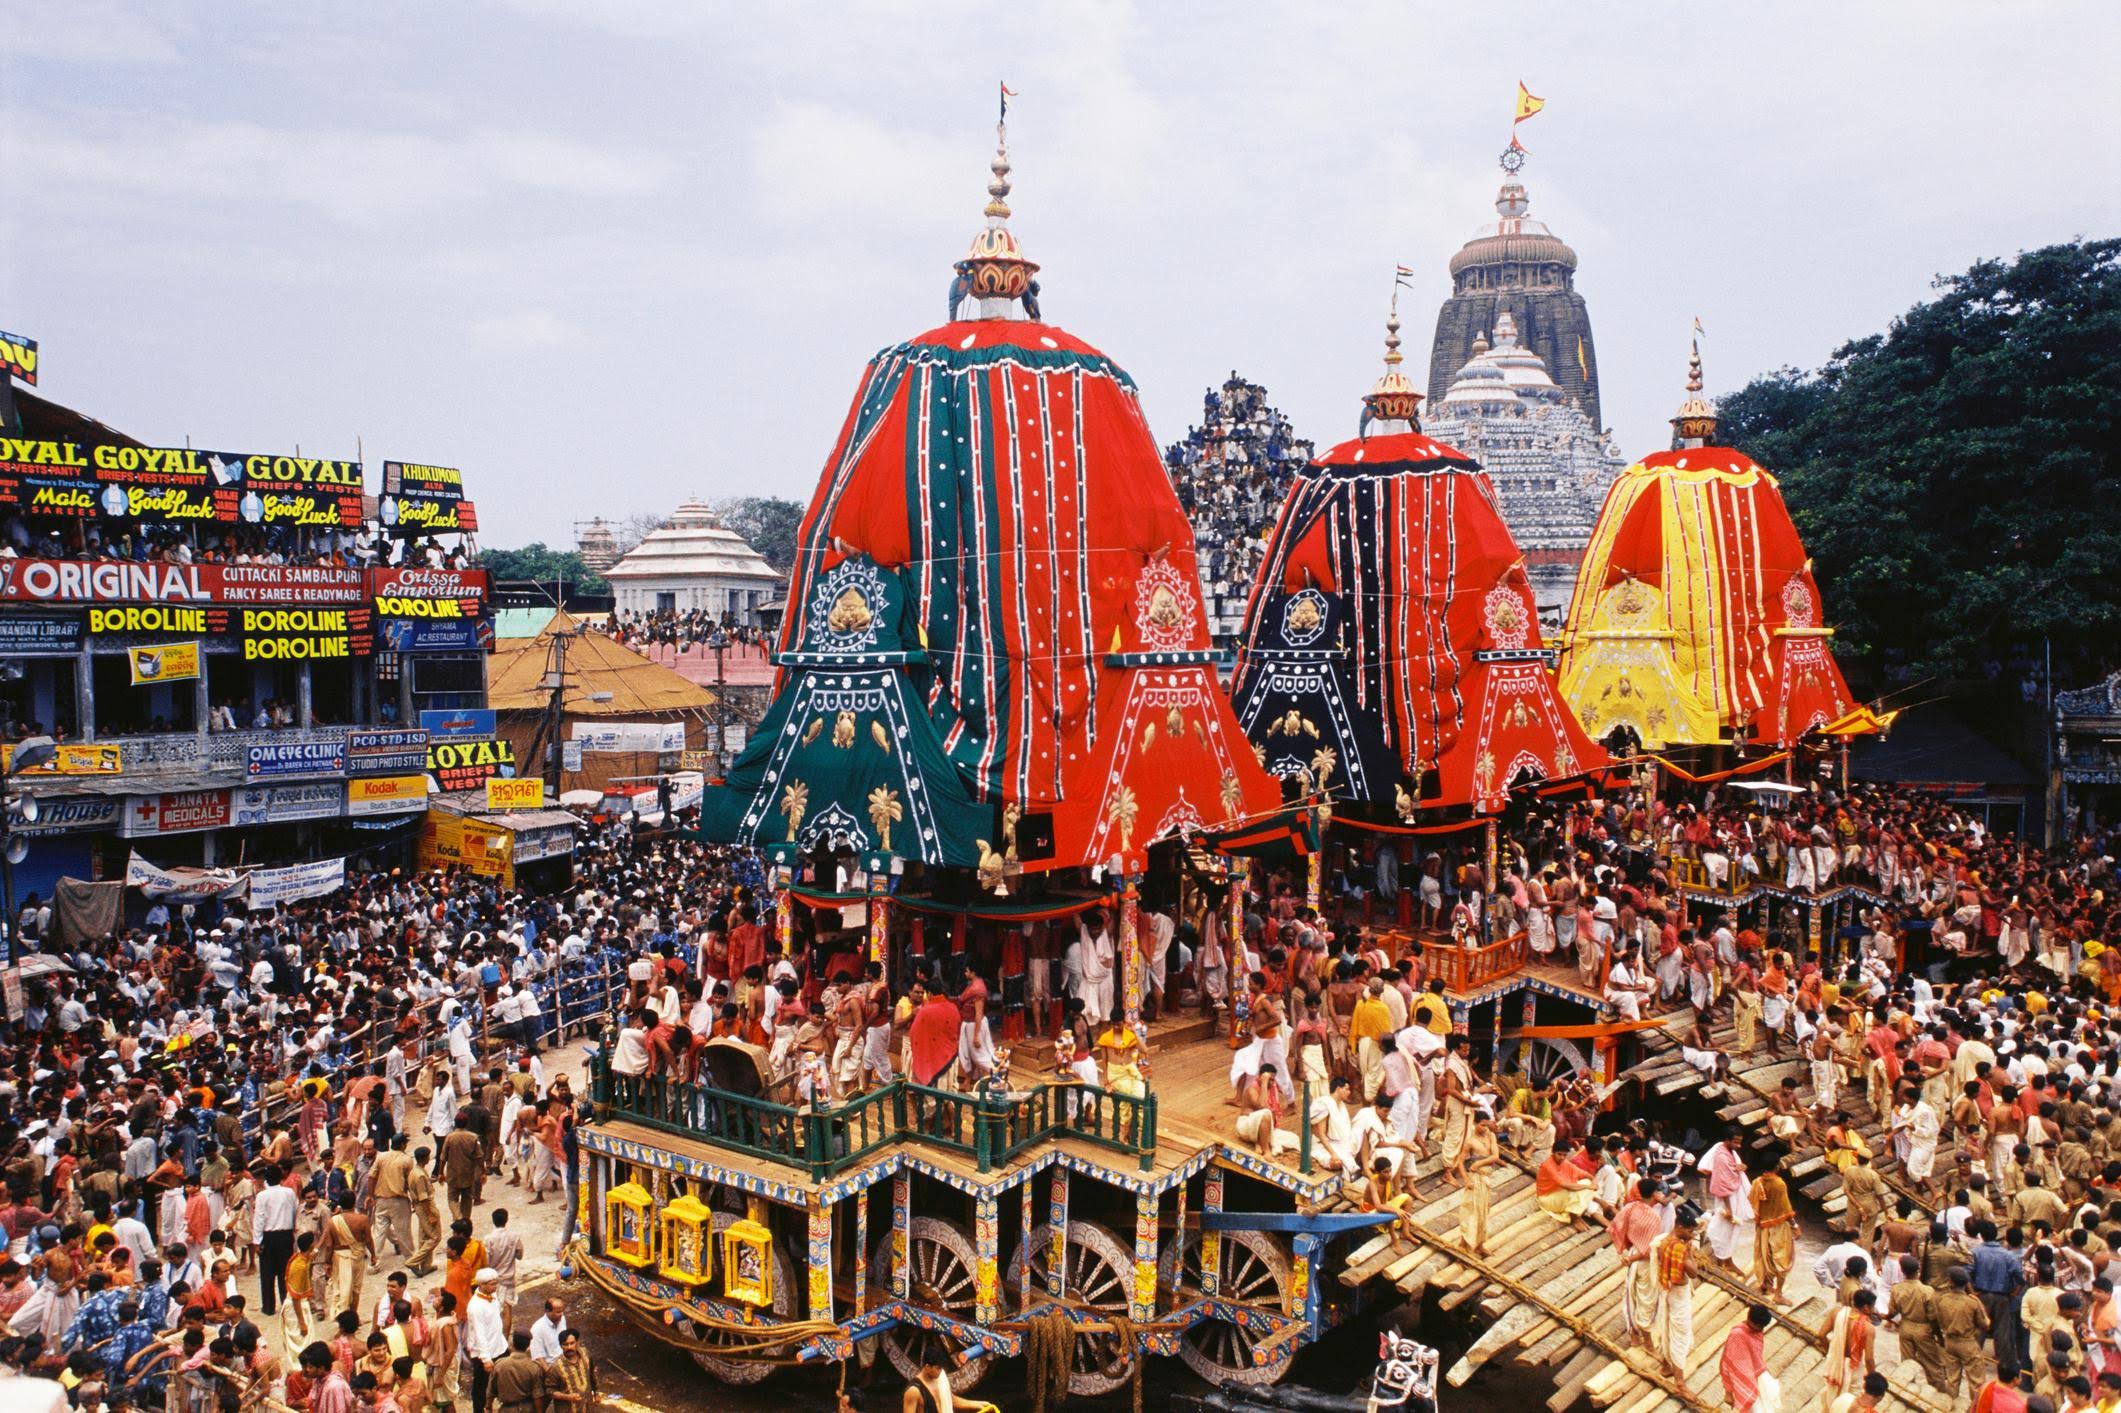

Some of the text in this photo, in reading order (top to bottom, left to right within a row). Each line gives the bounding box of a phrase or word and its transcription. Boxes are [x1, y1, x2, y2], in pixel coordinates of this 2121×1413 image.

[94, 445, 207, 474] GOYAL
[246, 455, 361, 485] GOYAL
[402, 463, 462, 485] KHUKUMONI
[246, 479, 361, 495] BRIEFS VESTS
[424, 481, 445, 491] ALTA
[32, 487, 95, 508] Mala
[127, 486, 215, 519] Good Luck
[263, 493, 340, 525] Good Luck
[398, 498, 459, 528] Good Luck
[23, 562, 212, 600] ORIGINAL
[222, 567, 362, 583] CUTTACKI SAMBALPURI
[399, 569, 461, 586] Orissa
[223, 587, 362, 601] FANCY SAREE & READYMADE
[382, 582, 483, 598] Emporium
[375, 597, 462, 617] BOROLINE
[90, 607, 207, 633] BOROLINE
[243, 610, 347, 631] BOROLINE
[431, 621, 457, 631] SHYAMA
[40, 625, 79, 636] LIBRARY
[244, 637, 349, 660] BOROLINE
[250, 747, 277, 761] OM
[278, 746, 303, 760] EYE
[304, 744, 344, 758] CLINIC
[351, 755, 425, 770] STUDIO PHOTO STYLE
[439, 765, 496, 779] BRIEFS
[364, 780, 399, 795] Kodak
[171, 791, 220, 808] JANATA
[51, 802, 114, 823] House
[164, 806, 225, 824] MEDICALS
[437, 842, 461, 858] Kodak
[483, 859, 507, 872] FILM
